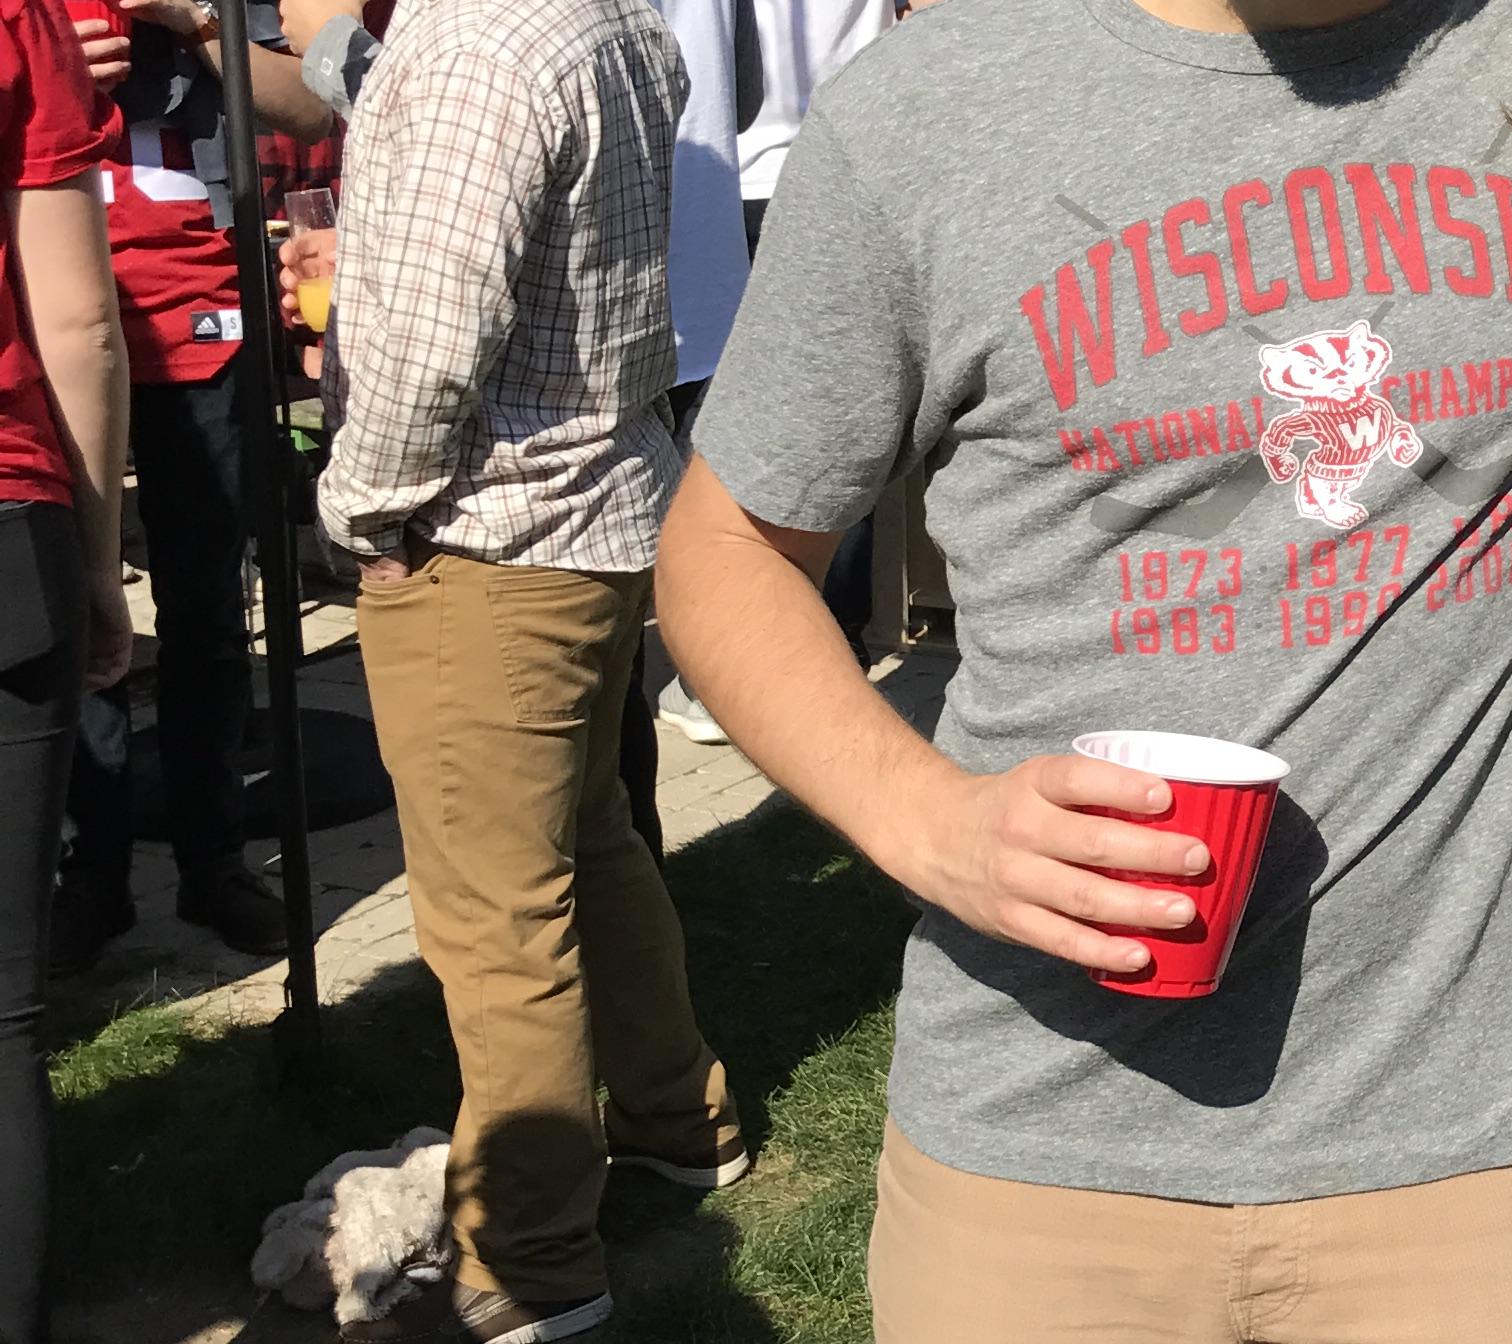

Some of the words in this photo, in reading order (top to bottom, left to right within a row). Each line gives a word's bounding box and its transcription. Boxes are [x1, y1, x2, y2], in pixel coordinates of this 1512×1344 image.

[1338, 407, 1382, 452] W
[1118, 547, 1243, 603] 1973
[1285, 524, 1410, 592] 1977
[1110, 603, 1236, 655] 1983
